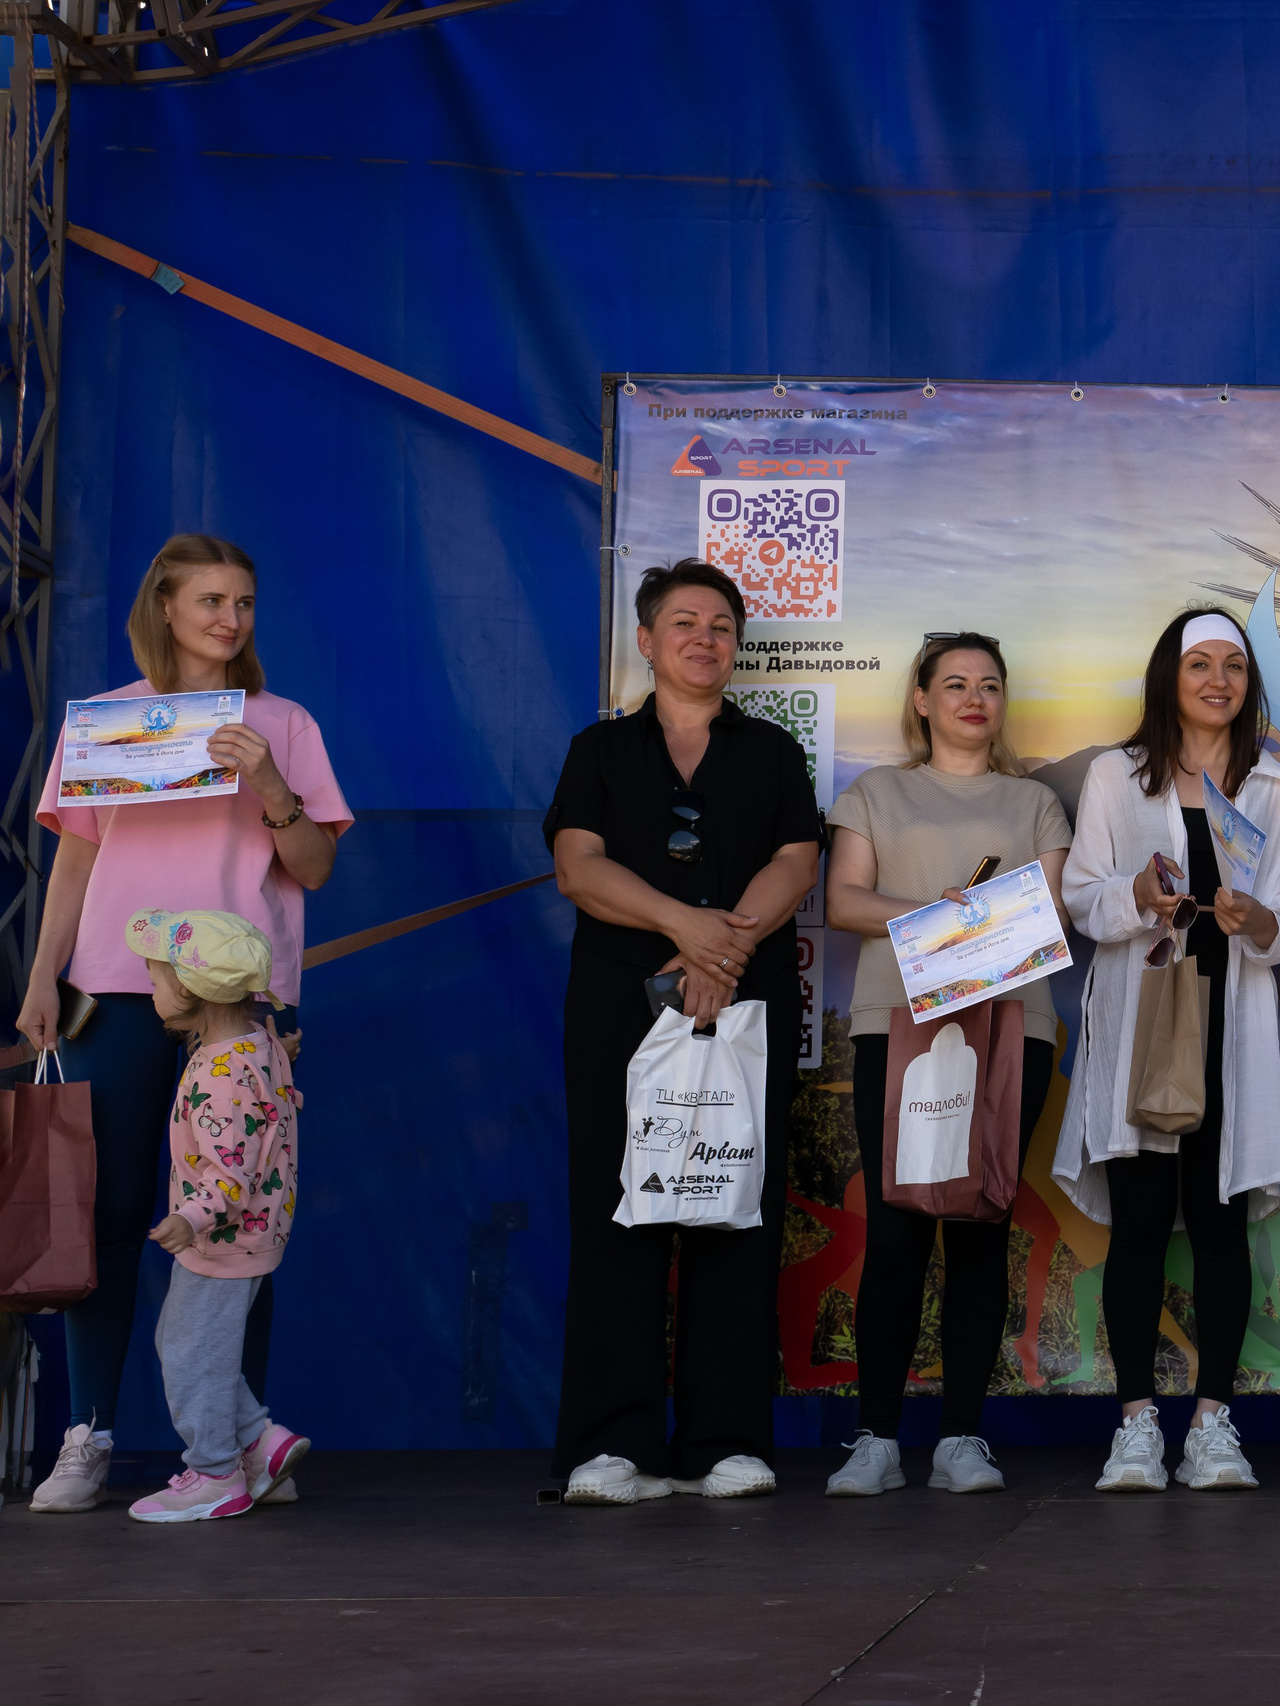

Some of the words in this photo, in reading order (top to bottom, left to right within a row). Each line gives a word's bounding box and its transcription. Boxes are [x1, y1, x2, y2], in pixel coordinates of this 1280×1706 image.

[648, 403, 687, 421] При
[693, 406, 805, 422] поддержке
[811, 408, 908, 421] магазина
[721, 437, 878, 456] ARSENAL
[738, 459, 851, 477] SPORT
[766, 656, 881, 673] Давыдовой
[119, 740, 193, 754] Благодарность
[948, 926, 1015, 955] Благодарность
[656, 1088, 674, 1102] ТЦ
[688, 1140, 755, 1165] Арбат
[666, 1174, 735, 1185] ARSENAL
[672, 1185, 723, 1196] SPORT
